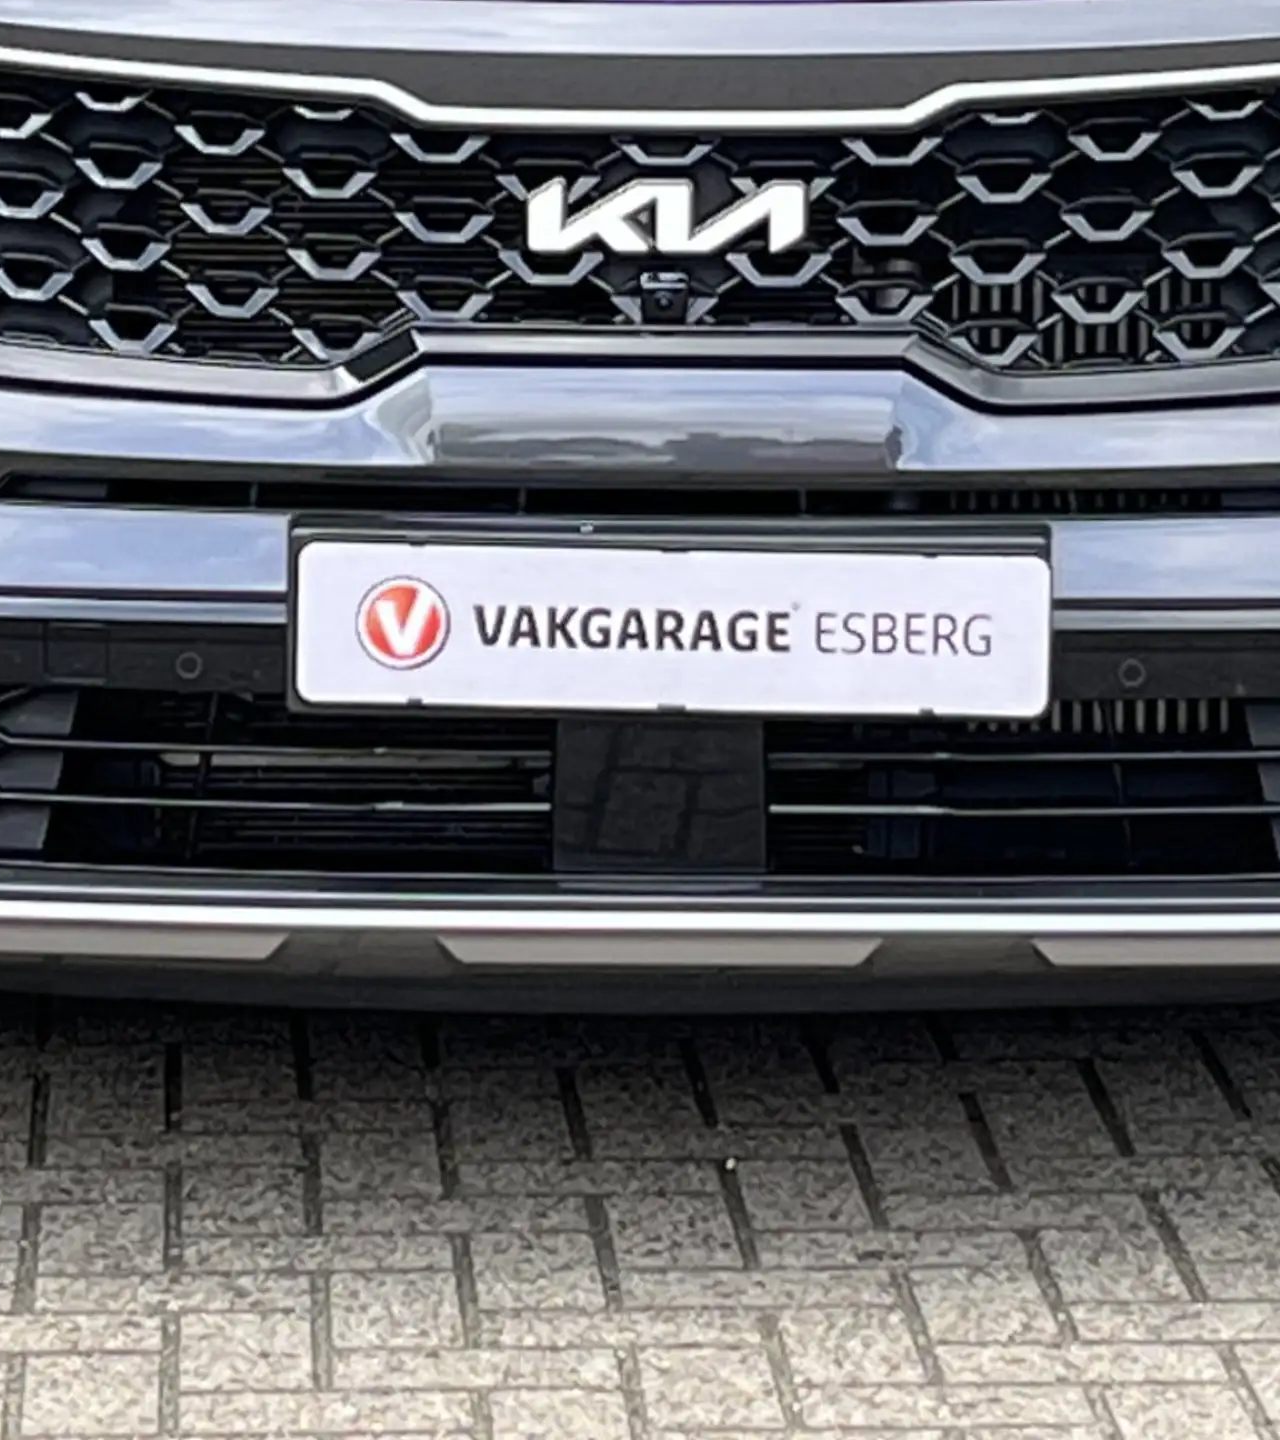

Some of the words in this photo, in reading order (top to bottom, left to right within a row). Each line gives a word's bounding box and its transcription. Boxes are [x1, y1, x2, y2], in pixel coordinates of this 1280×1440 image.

[527, 178, 806, 253] KIA
[473, 605, 790, 653] VAKGARAGE
[815, 611, 993, 657] ESBERG
